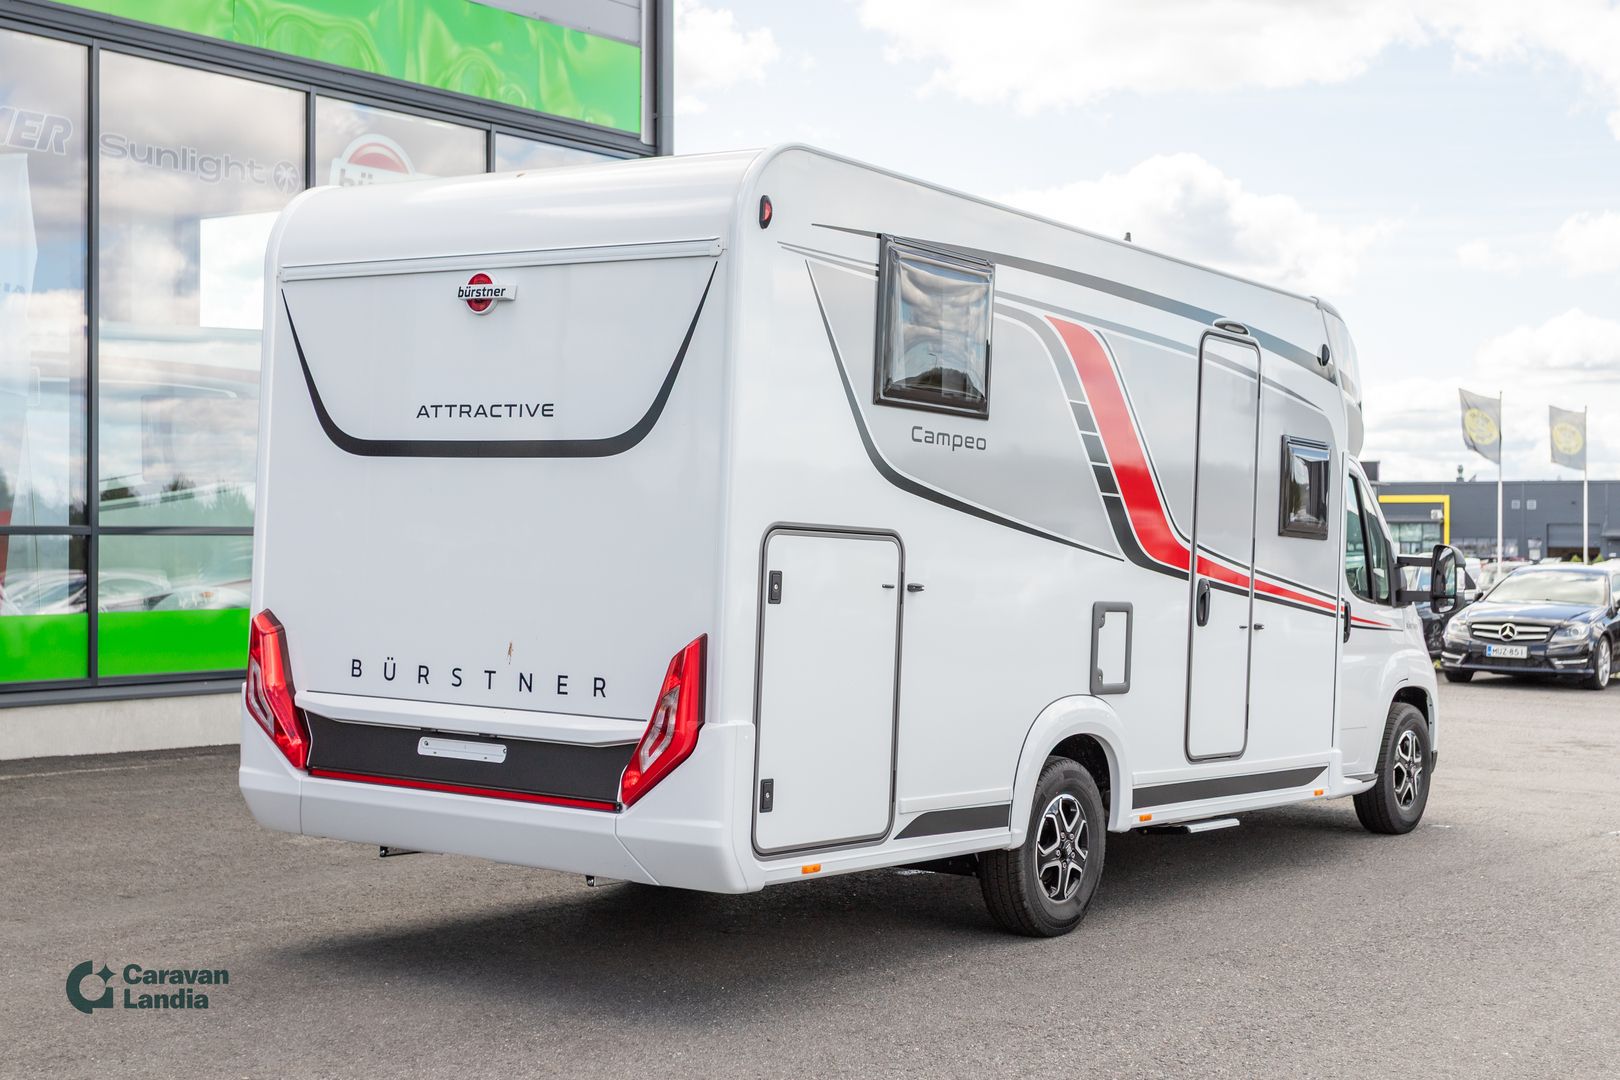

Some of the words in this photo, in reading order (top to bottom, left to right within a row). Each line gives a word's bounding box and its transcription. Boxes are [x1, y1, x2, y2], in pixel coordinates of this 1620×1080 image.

[99, 133, 267, 184] Sunlight
[457, 286, 506, 298] bürstner
[416, 403, 555, 419] ATTRACTIVE
[911, 425, 987, 452] Campeo
[350, 656, 607, 698] BÜRSTNER
